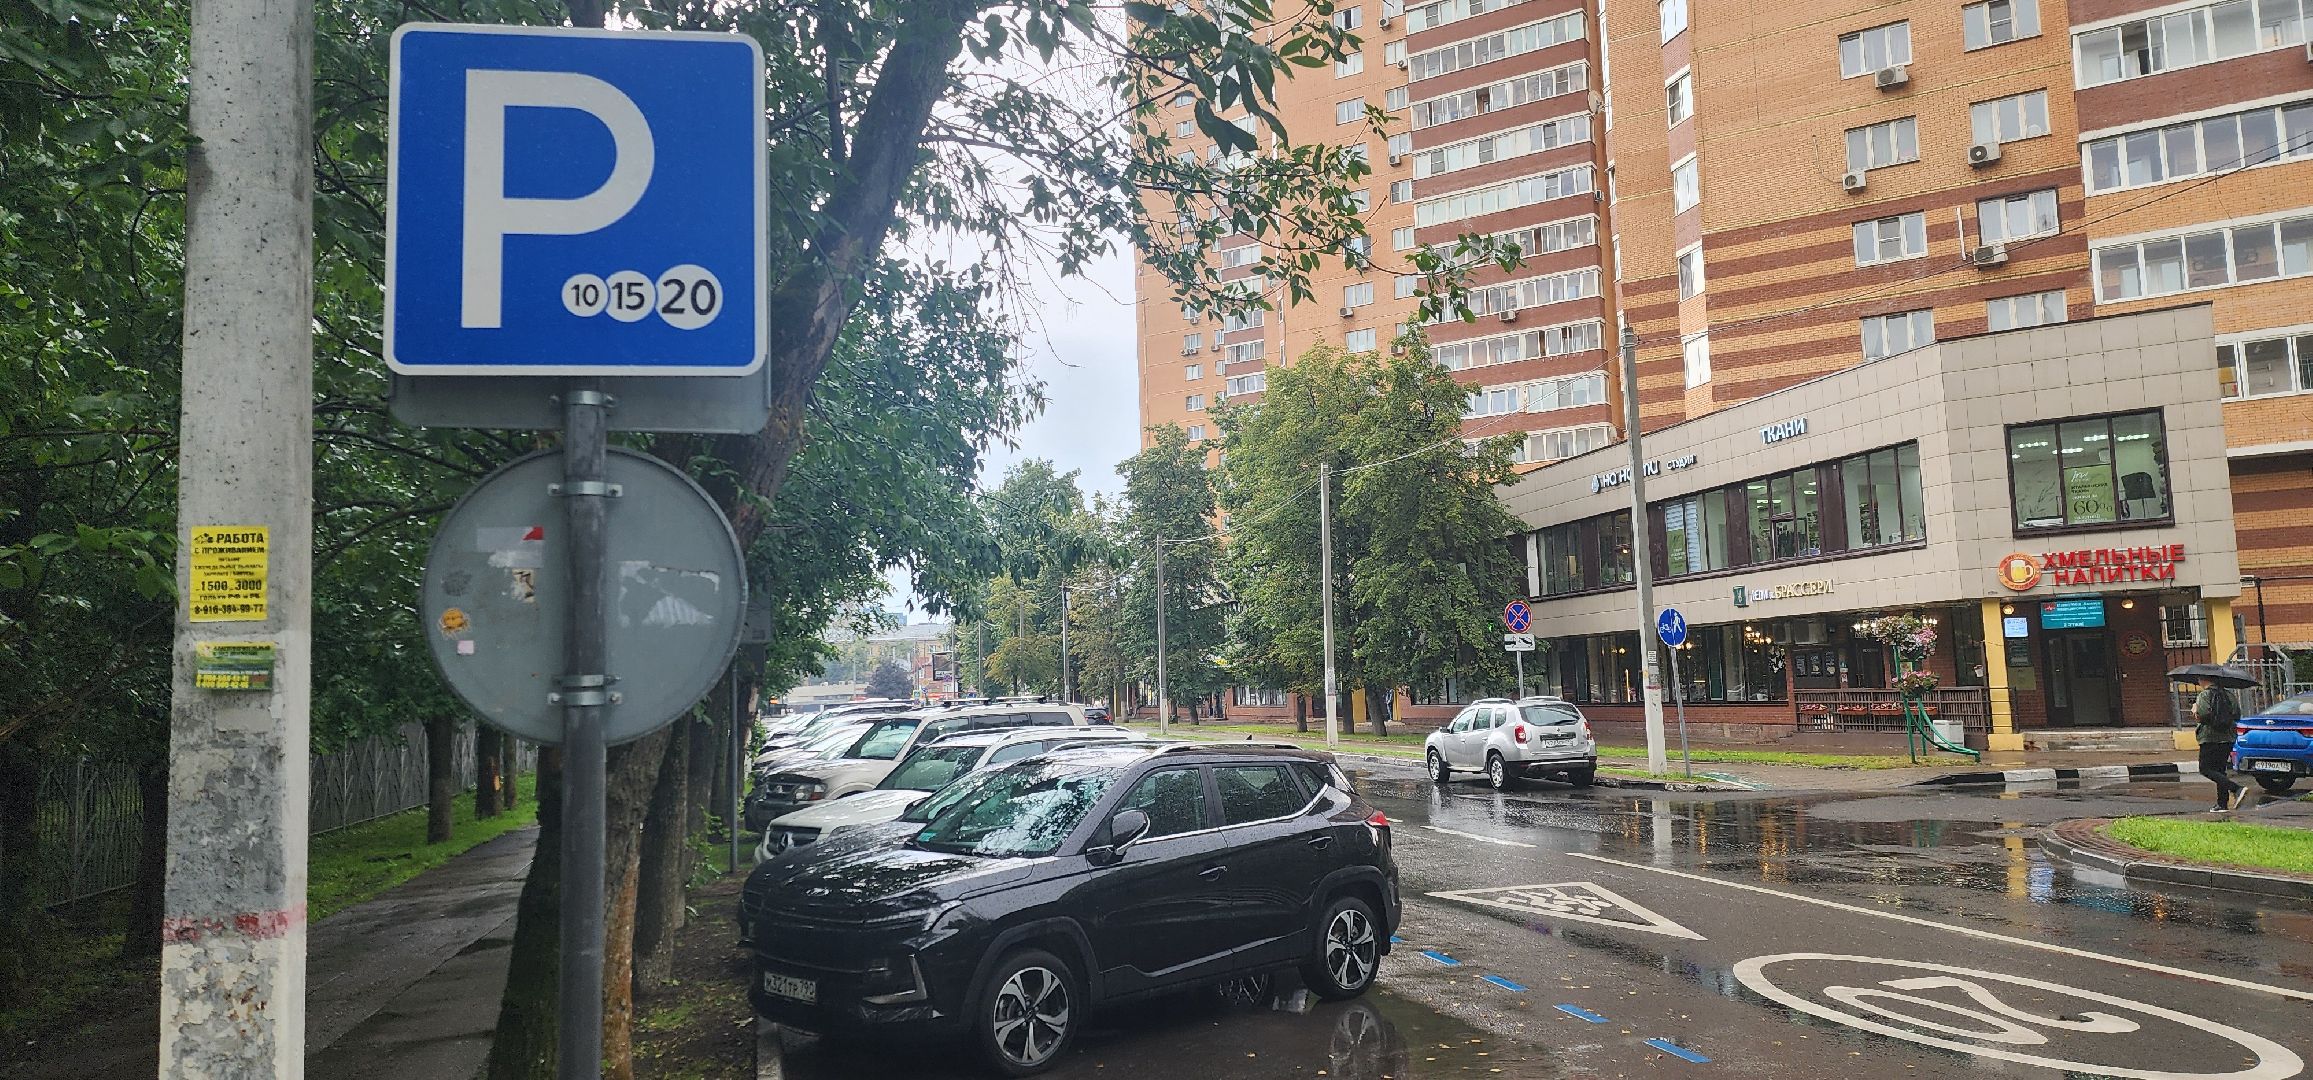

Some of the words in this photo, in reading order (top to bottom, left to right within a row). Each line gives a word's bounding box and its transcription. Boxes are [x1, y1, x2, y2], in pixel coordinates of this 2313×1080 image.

[462, 68, 655, 328] P
[570, 283, 599, 307] 10
[612, 282, 645, 310] 15
[661, 278, 716, 316] 20
[1759, 417, 1807, 445] ТКАНИ
[216, 533, 264, 544] РАБОТА
[2042, 544, 2185, 570] ХМЕЛЬНЫЕ
[2054, 561, 2176, 586] НАПИТКИ
[1774, 579, 1834, 598] БРАССЕРИ
